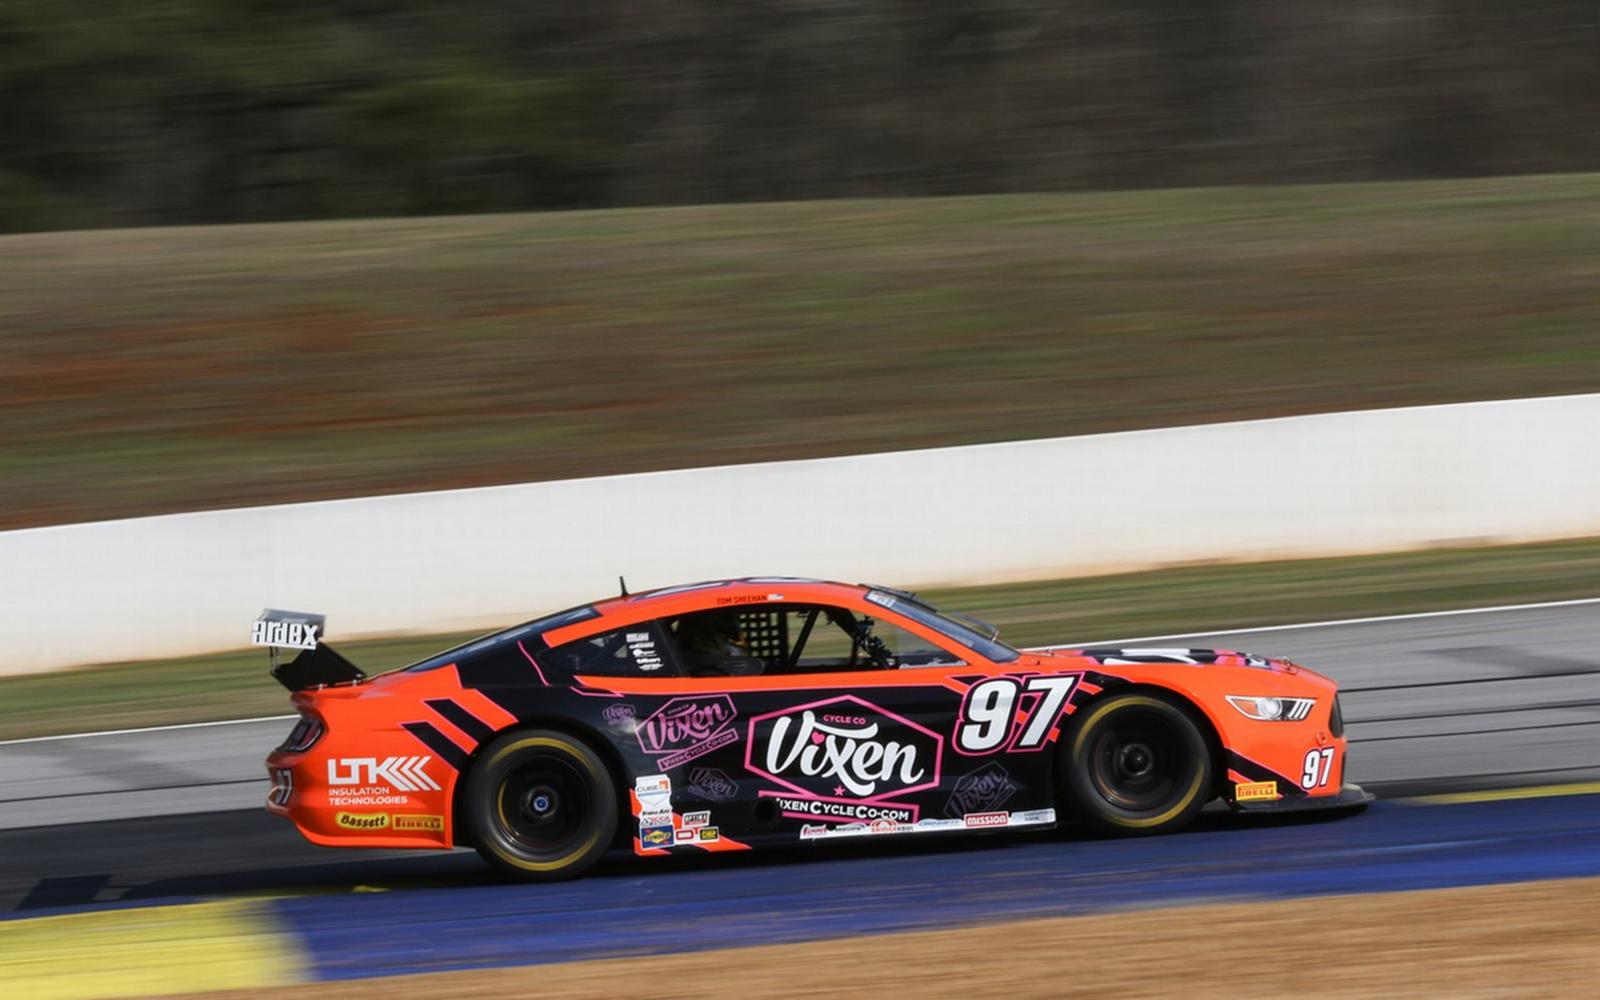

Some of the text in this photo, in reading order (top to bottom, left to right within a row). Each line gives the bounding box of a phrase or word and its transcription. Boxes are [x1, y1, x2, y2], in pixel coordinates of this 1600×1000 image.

[646, 703, 729, 750] Vixen
[822, 714, 867, 726] CYCLE CO
[956, 674, 1078, 753] 97
[766, 710, 925, 797] Vixen
[1300, 746, 1336, 791] 97
[328, 786, 390, 797] INSULATION
[328, 795, 408, 806] TECHNOLOGIES
[340, 814, 386, 829] Bassett
